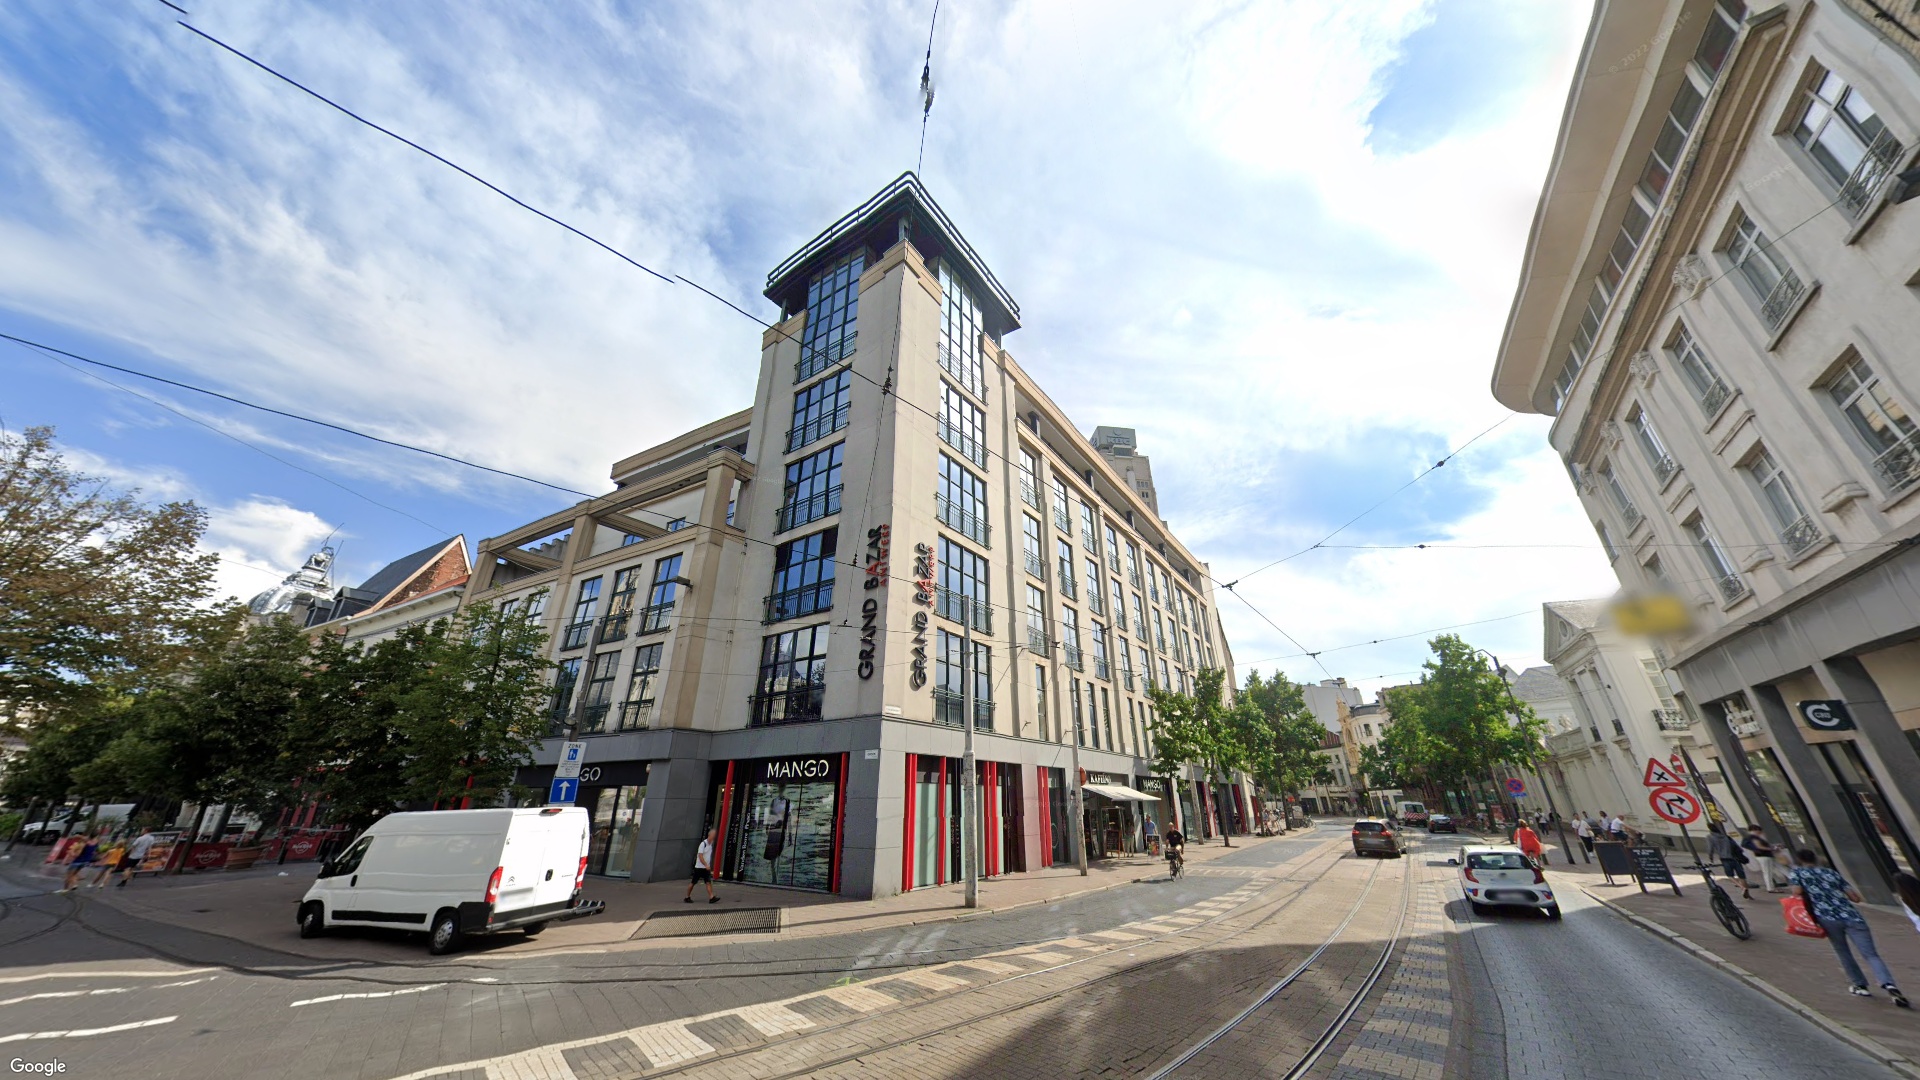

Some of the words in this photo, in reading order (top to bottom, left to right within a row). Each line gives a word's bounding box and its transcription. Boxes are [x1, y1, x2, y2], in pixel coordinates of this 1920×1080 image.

[864, 524, 882, 590] BAZAR
[879, 523, 890, 586] ANTWERP
[917, 542, 931, 605] BAZAR
[857, 597, 878, 680] GRAND
[913, 611, 928, 688] GRAND
[767, 759, 829, 779] MANGO
